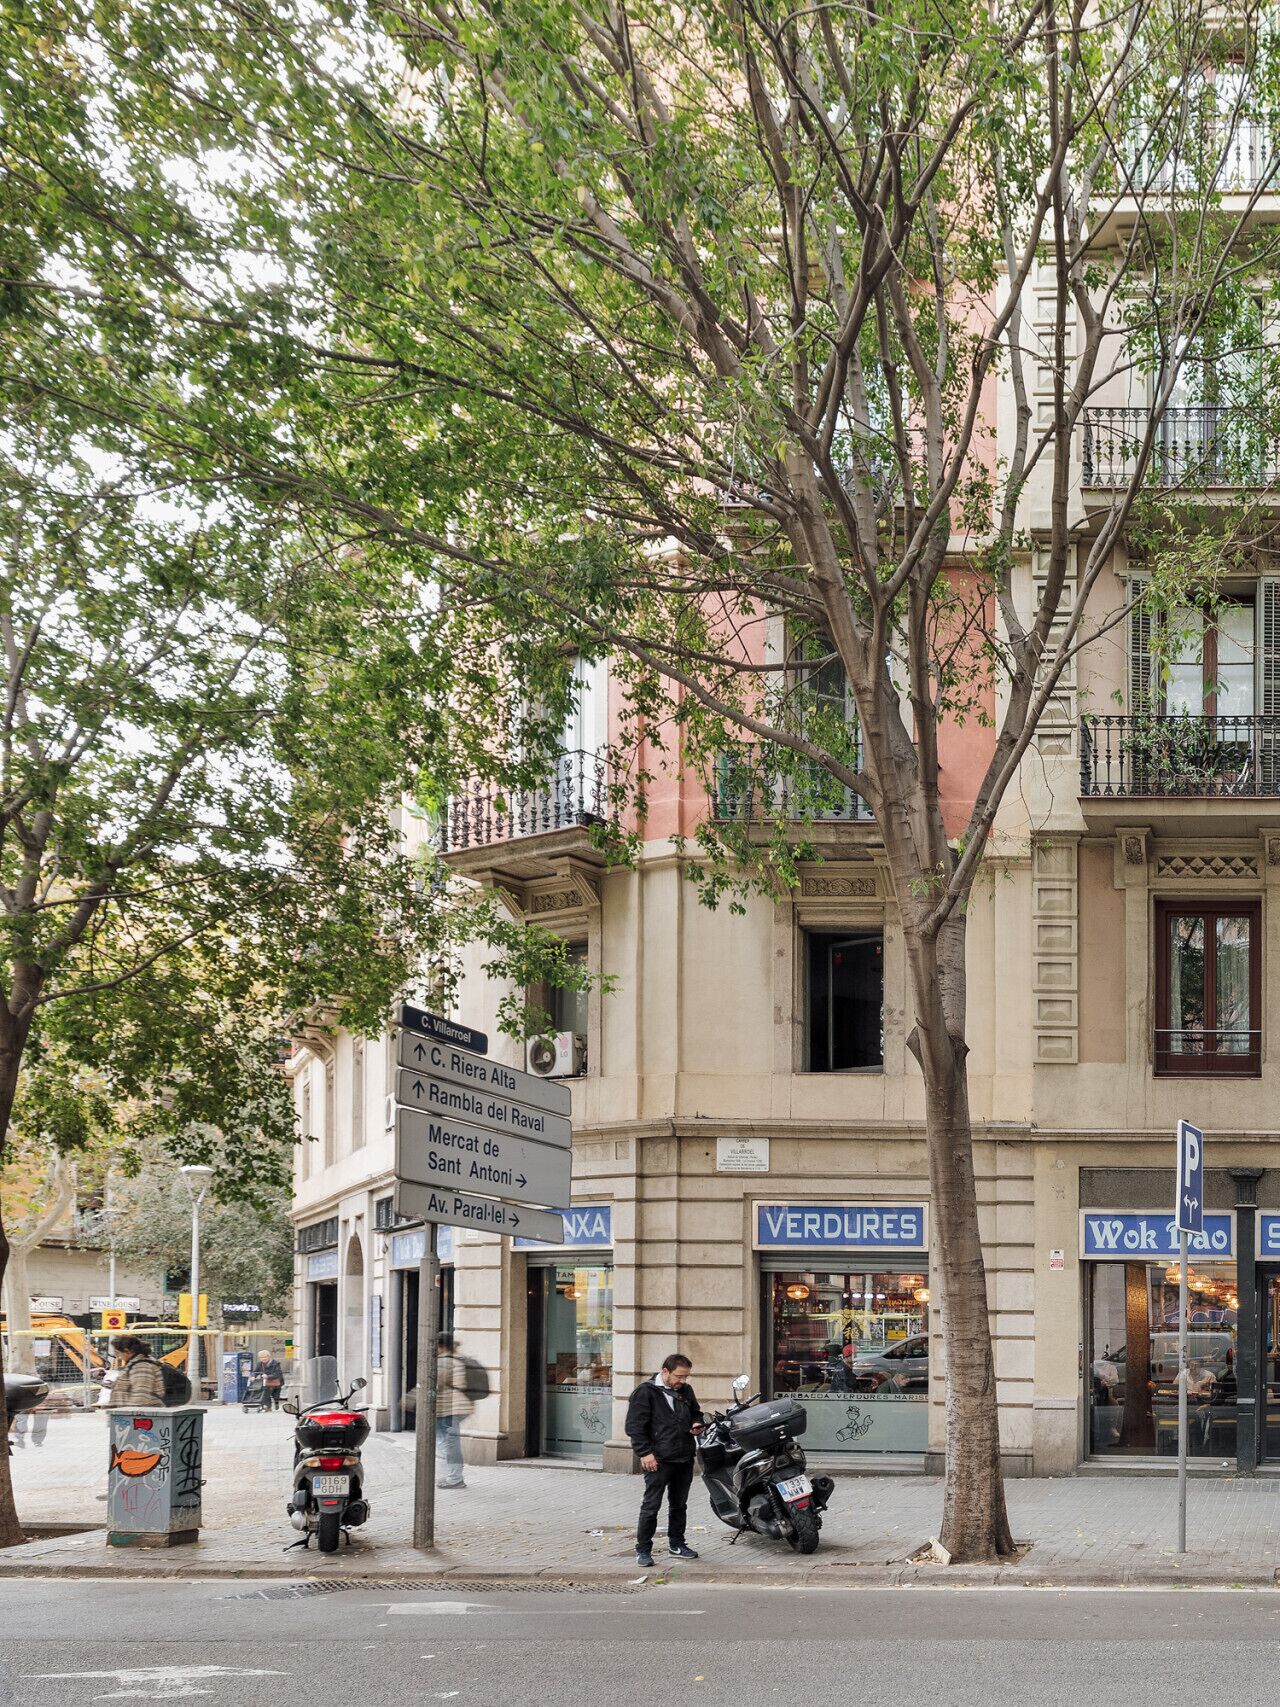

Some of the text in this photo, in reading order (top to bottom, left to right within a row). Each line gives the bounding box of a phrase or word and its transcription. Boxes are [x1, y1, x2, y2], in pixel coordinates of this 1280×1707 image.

[421, 1015, 471, 1043] C. Villarroel
[430, 1047, 516, 1090] C. Riera Alta
[429, 1083, 545, 1132] Rambla del Raval
[429, 1124, 499, 1157] Mercat de
[428, 1151, 512, 1186] Sant Antoni
[1185, 1130, 1200, 1188] P
[428, 1193, 505, 1224] Av. Paral·lel
[766, 1213, 917, 1239] VERDURES
[1088, 1220, 1159, 1249] Wok
[321, 1477, 347, 1485] 0169
[321, 1485, 342, 1494] GDH
